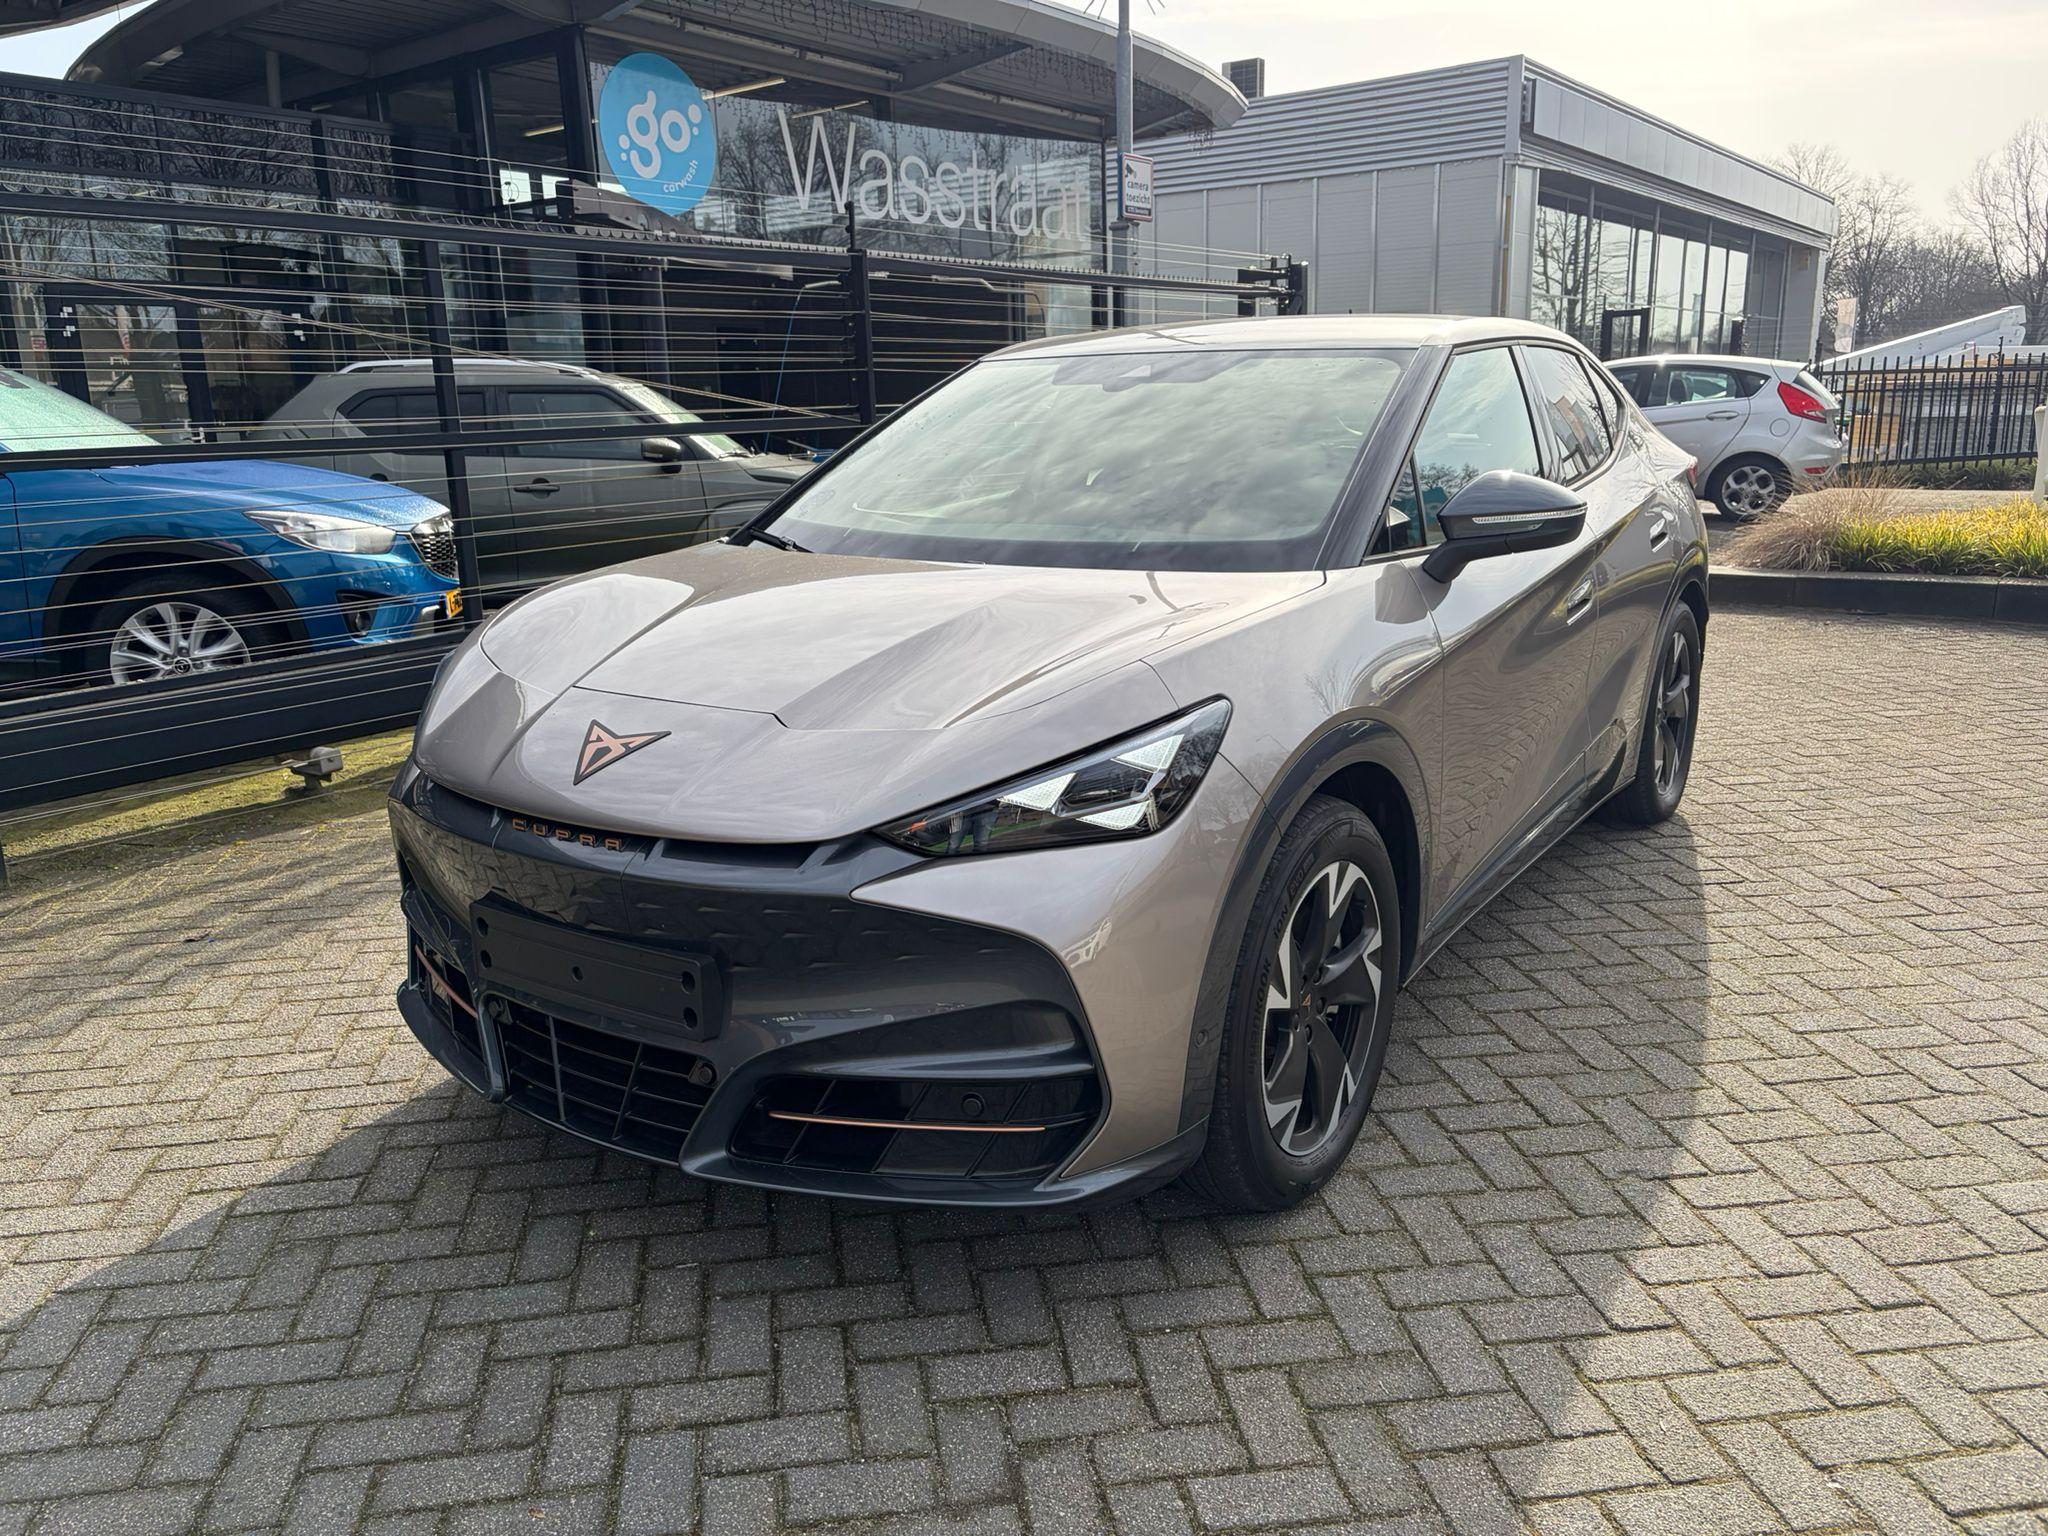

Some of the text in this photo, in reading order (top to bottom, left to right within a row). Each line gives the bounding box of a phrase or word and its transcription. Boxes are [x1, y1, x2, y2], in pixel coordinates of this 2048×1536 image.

[663, 159, 698, 193] carwash
[777, 104, 1088, 241] Wasstraat
[1127, 181, 1149, 191] camera
[1126, 193, 1150, 204] toezicht
[512, 818, 622, 850] CUPRA
